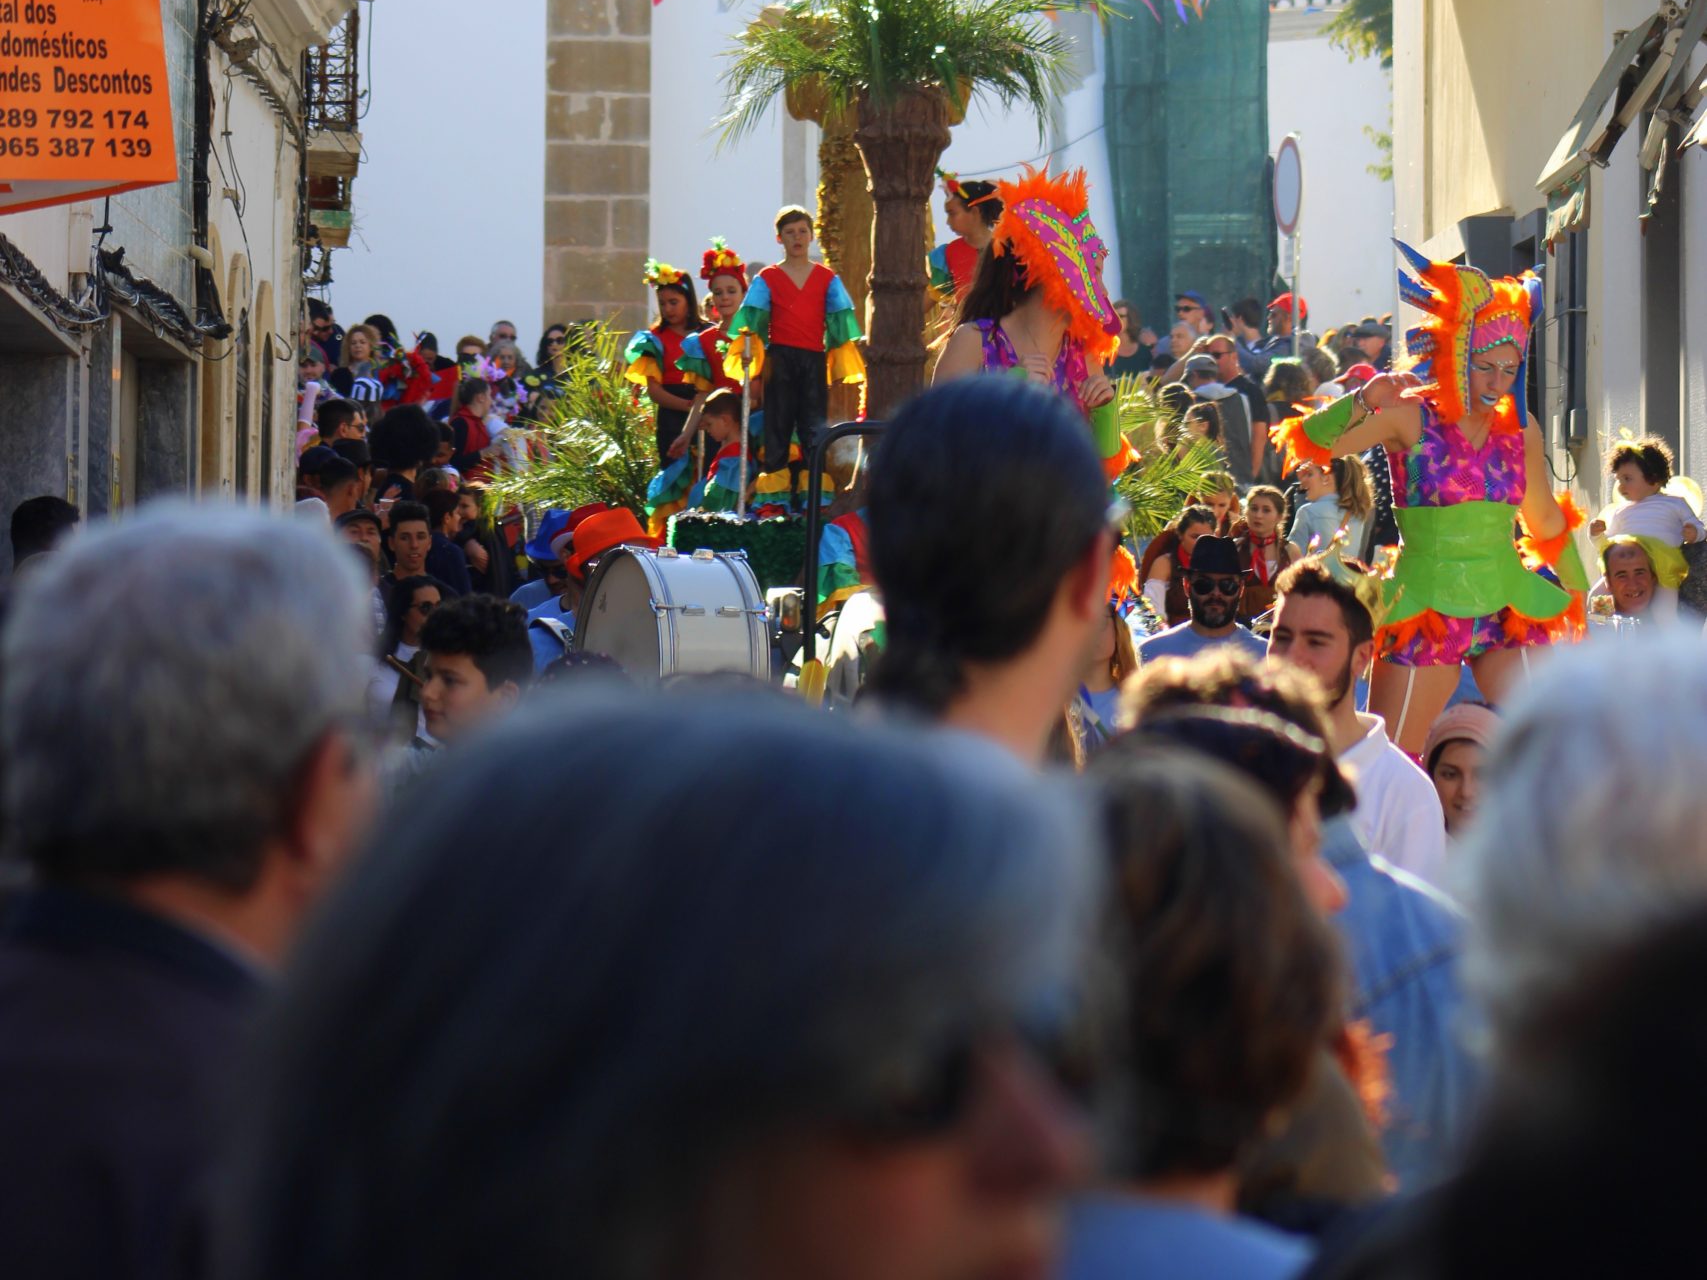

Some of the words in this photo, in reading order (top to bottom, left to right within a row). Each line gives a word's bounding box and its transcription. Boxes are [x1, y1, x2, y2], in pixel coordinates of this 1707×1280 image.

[2, 30, 108, 59] domésticos
[54, 66, 152, 95] Descontos
[46, 109, 94, 129] 792
[103, 110, 150, 130] 174
[48, 137, 95, 158] 387
[105, 138, 152, 158] 139
